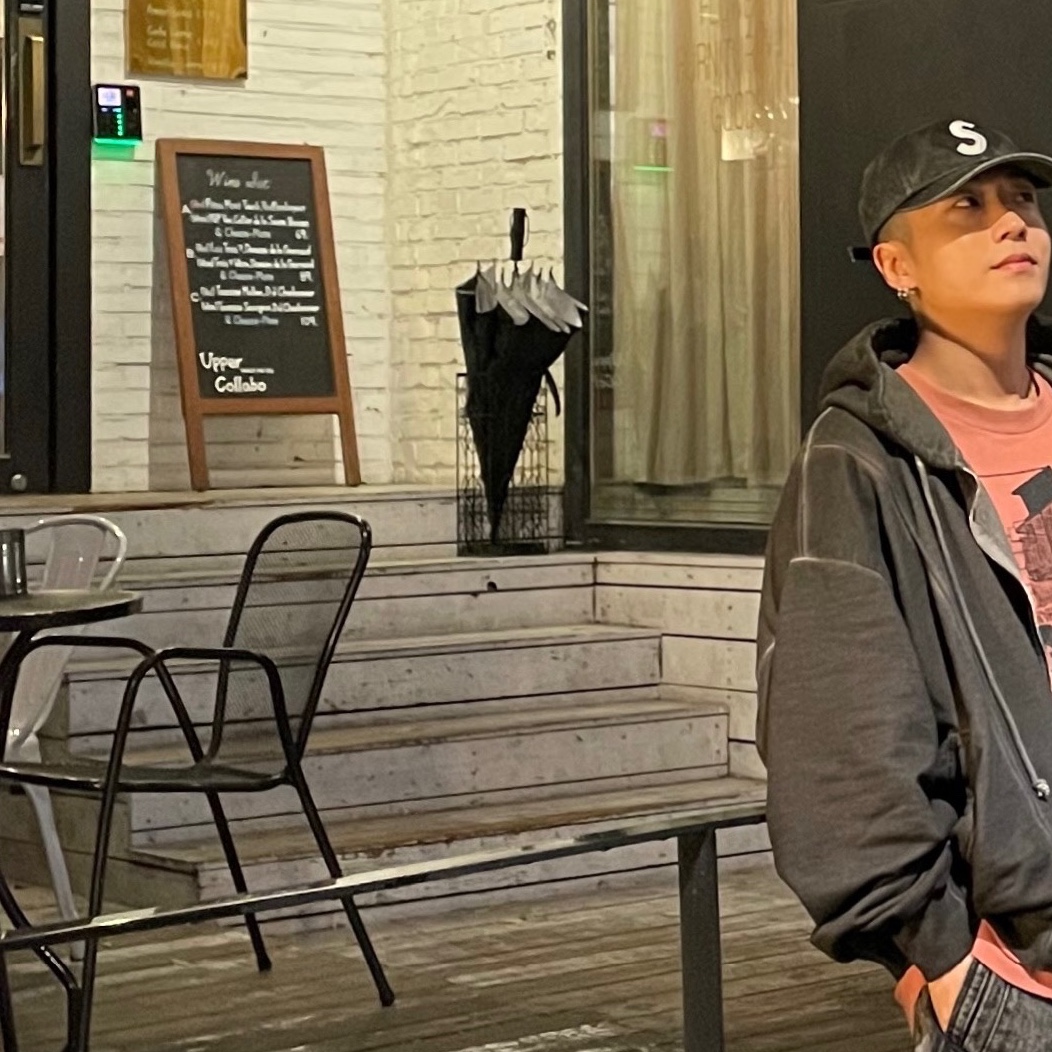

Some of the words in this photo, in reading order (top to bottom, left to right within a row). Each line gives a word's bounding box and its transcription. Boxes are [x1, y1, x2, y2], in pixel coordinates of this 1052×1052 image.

[948, 120, 987, 155] S
[199, 352, 243, 372] Upper
[214, 376, 267, 393] Collabo
